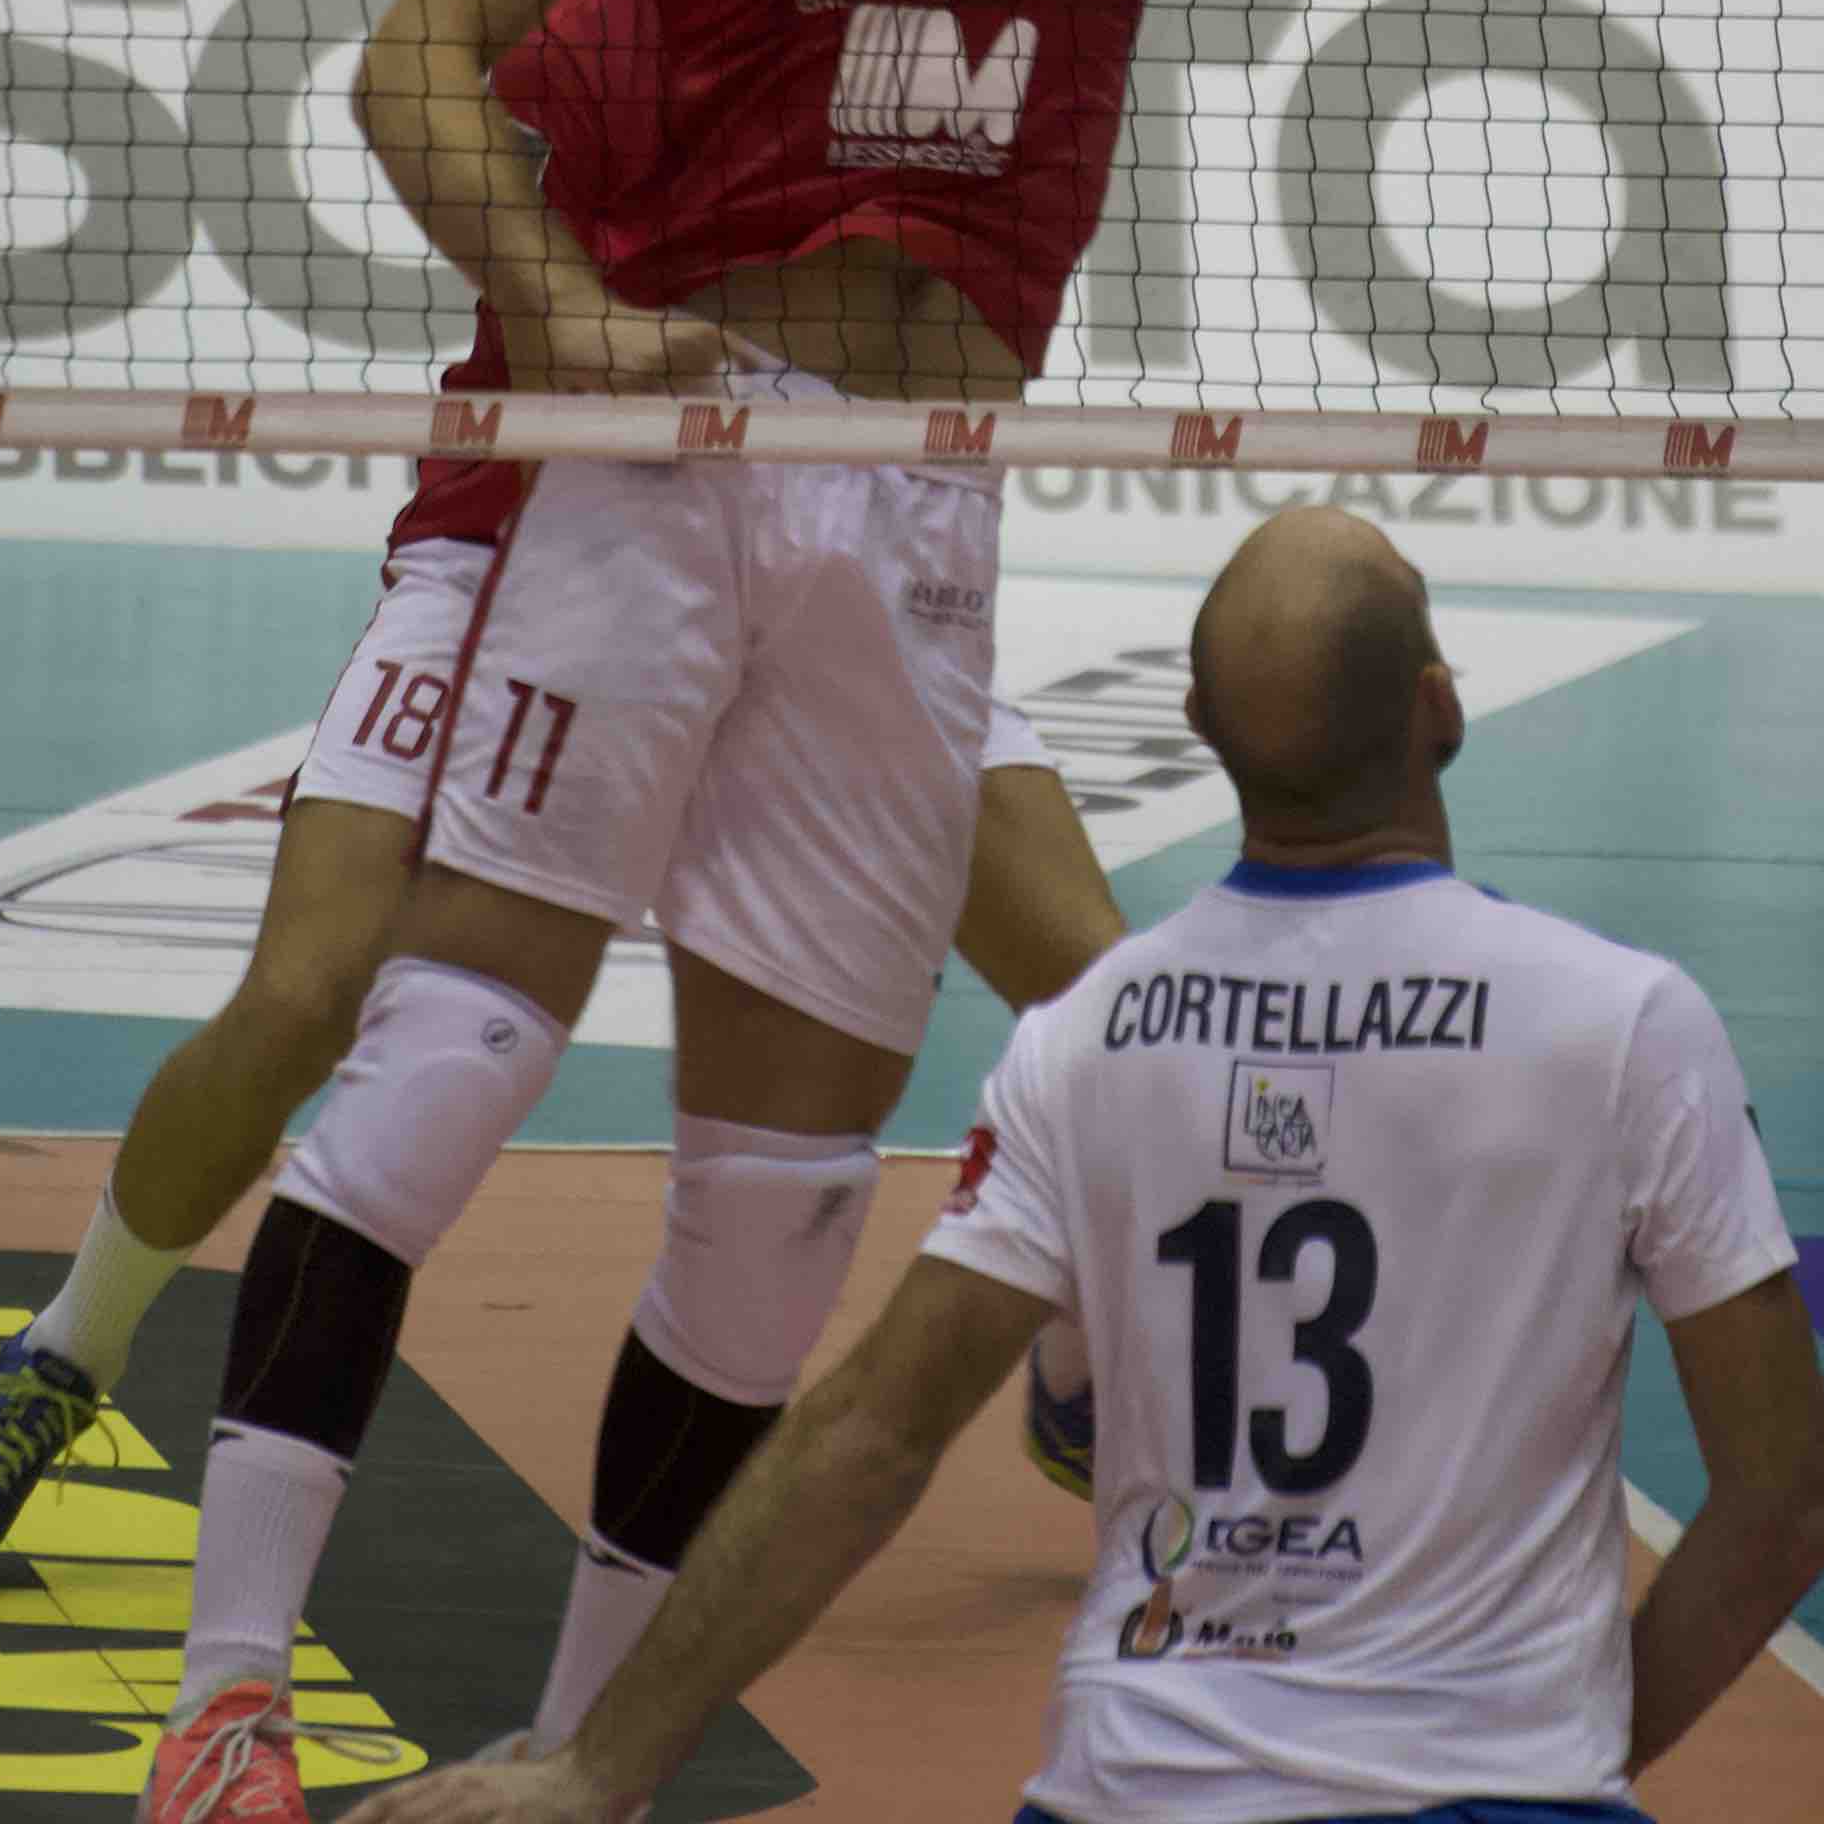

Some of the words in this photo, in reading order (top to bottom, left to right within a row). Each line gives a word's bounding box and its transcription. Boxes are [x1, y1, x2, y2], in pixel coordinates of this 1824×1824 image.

[351, 660, 451, 762] 18
[483, 677, 577, 814] 11
[1104, 972, 1490, 1054] CORTELLAZZI
[1157, 1198, 1378, 1497] 13
